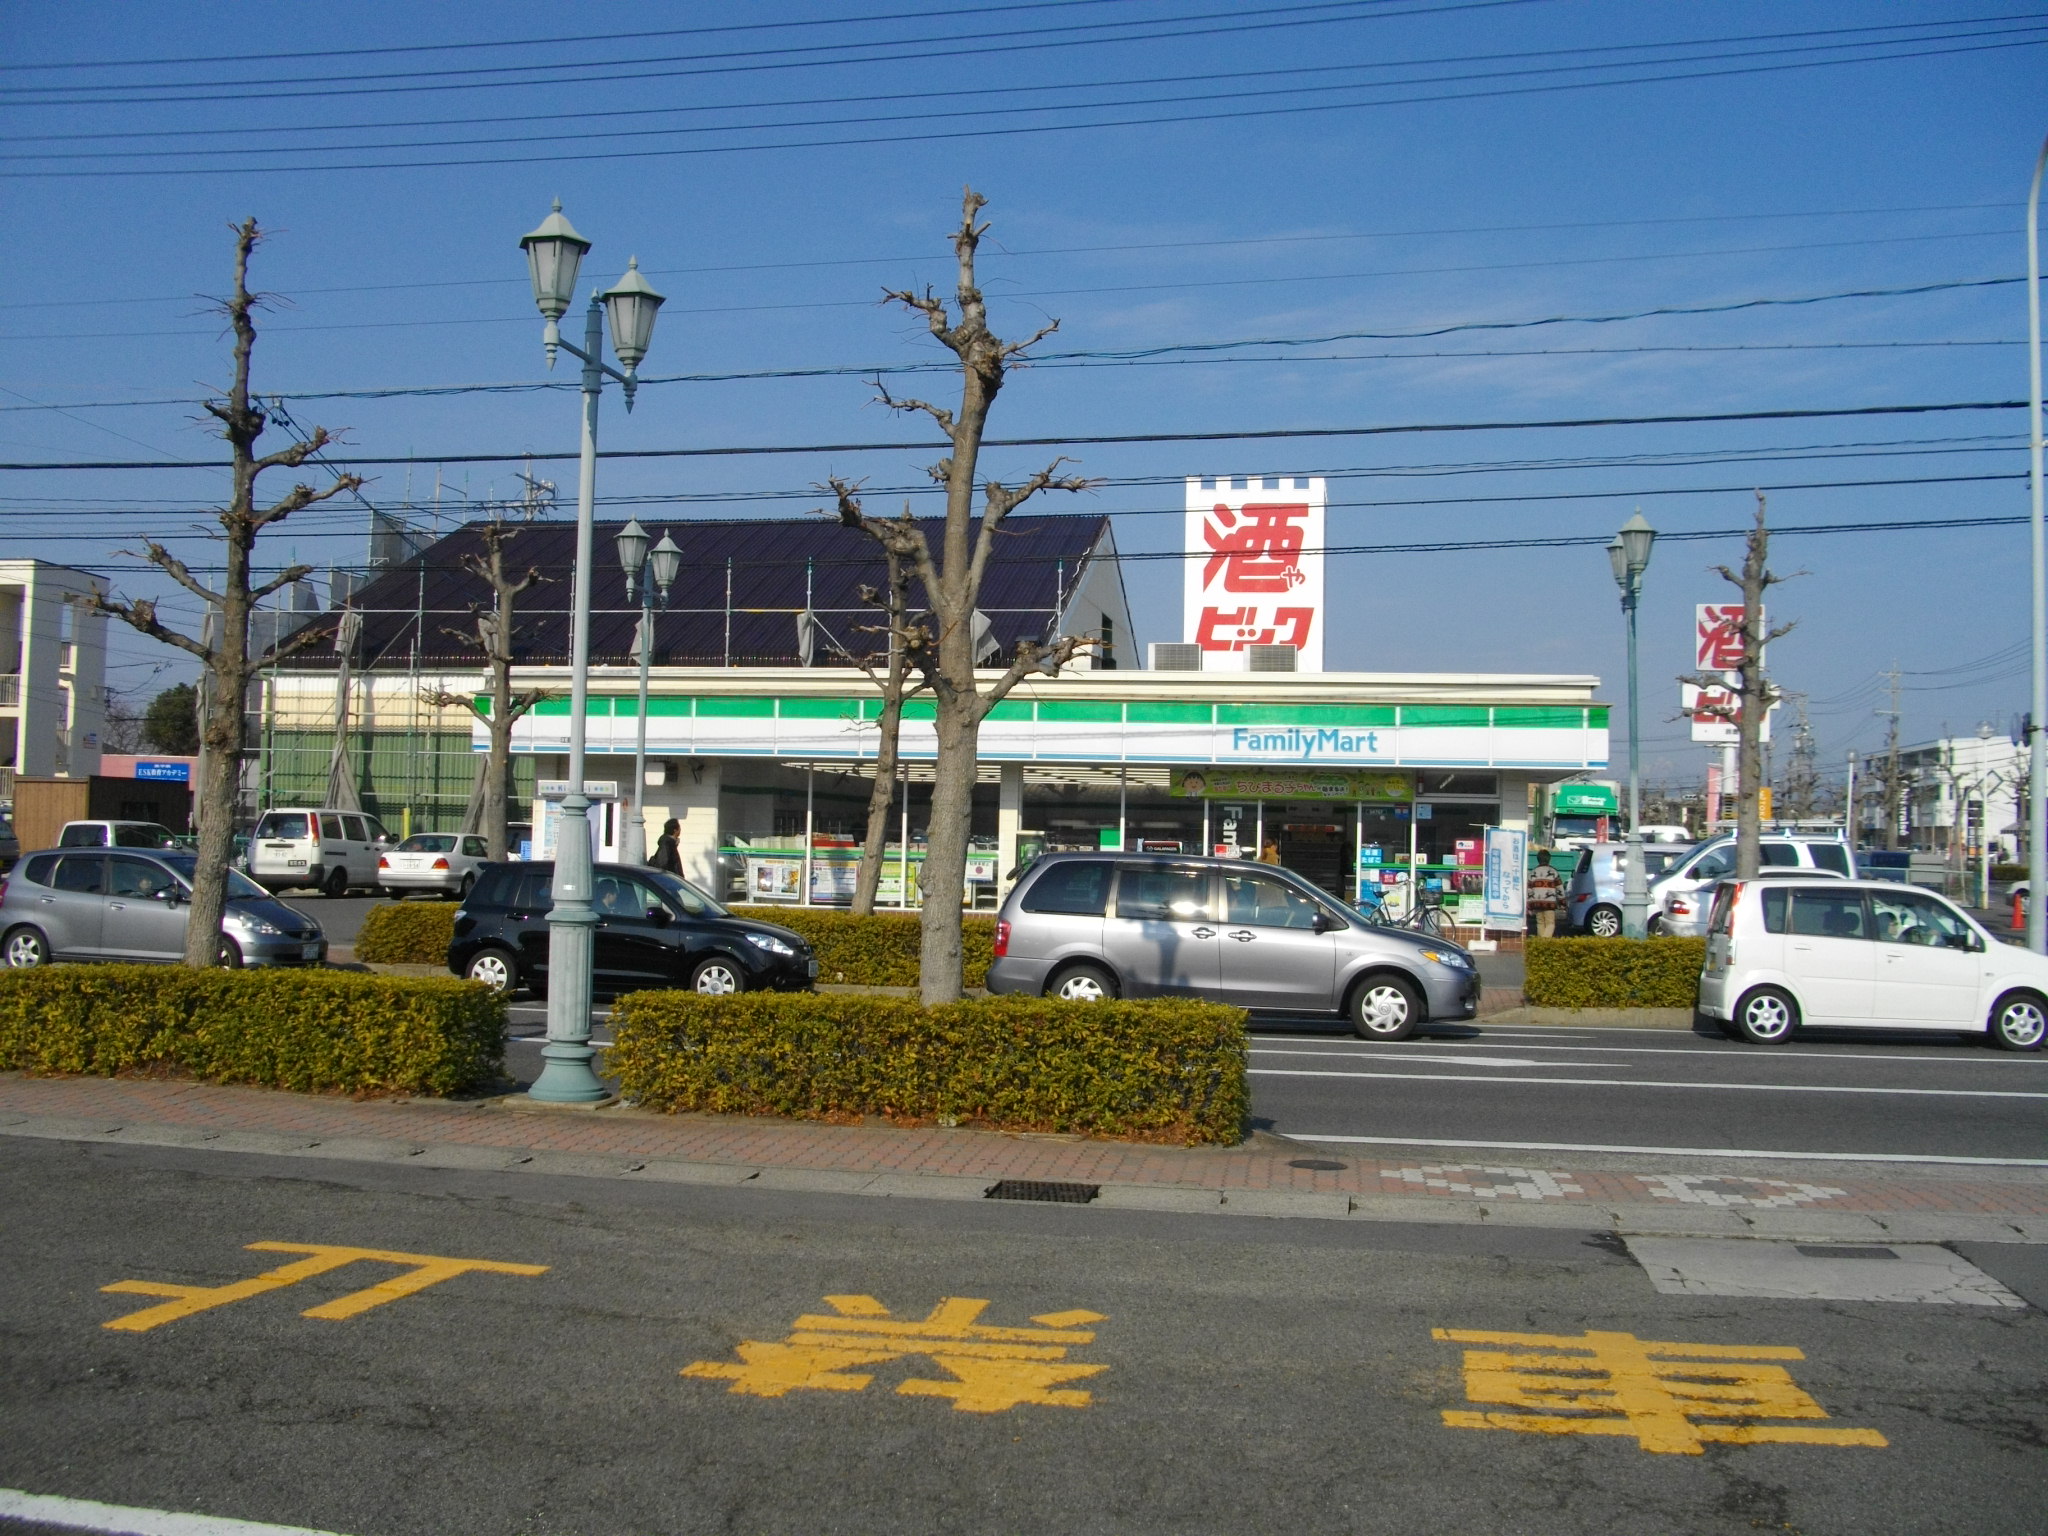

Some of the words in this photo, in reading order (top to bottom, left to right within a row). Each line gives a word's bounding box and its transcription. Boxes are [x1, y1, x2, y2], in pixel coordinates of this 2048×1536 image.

[1195, 607, 1315, 652] ビック
[1233, 728, 1378, 758] FamilyMart
